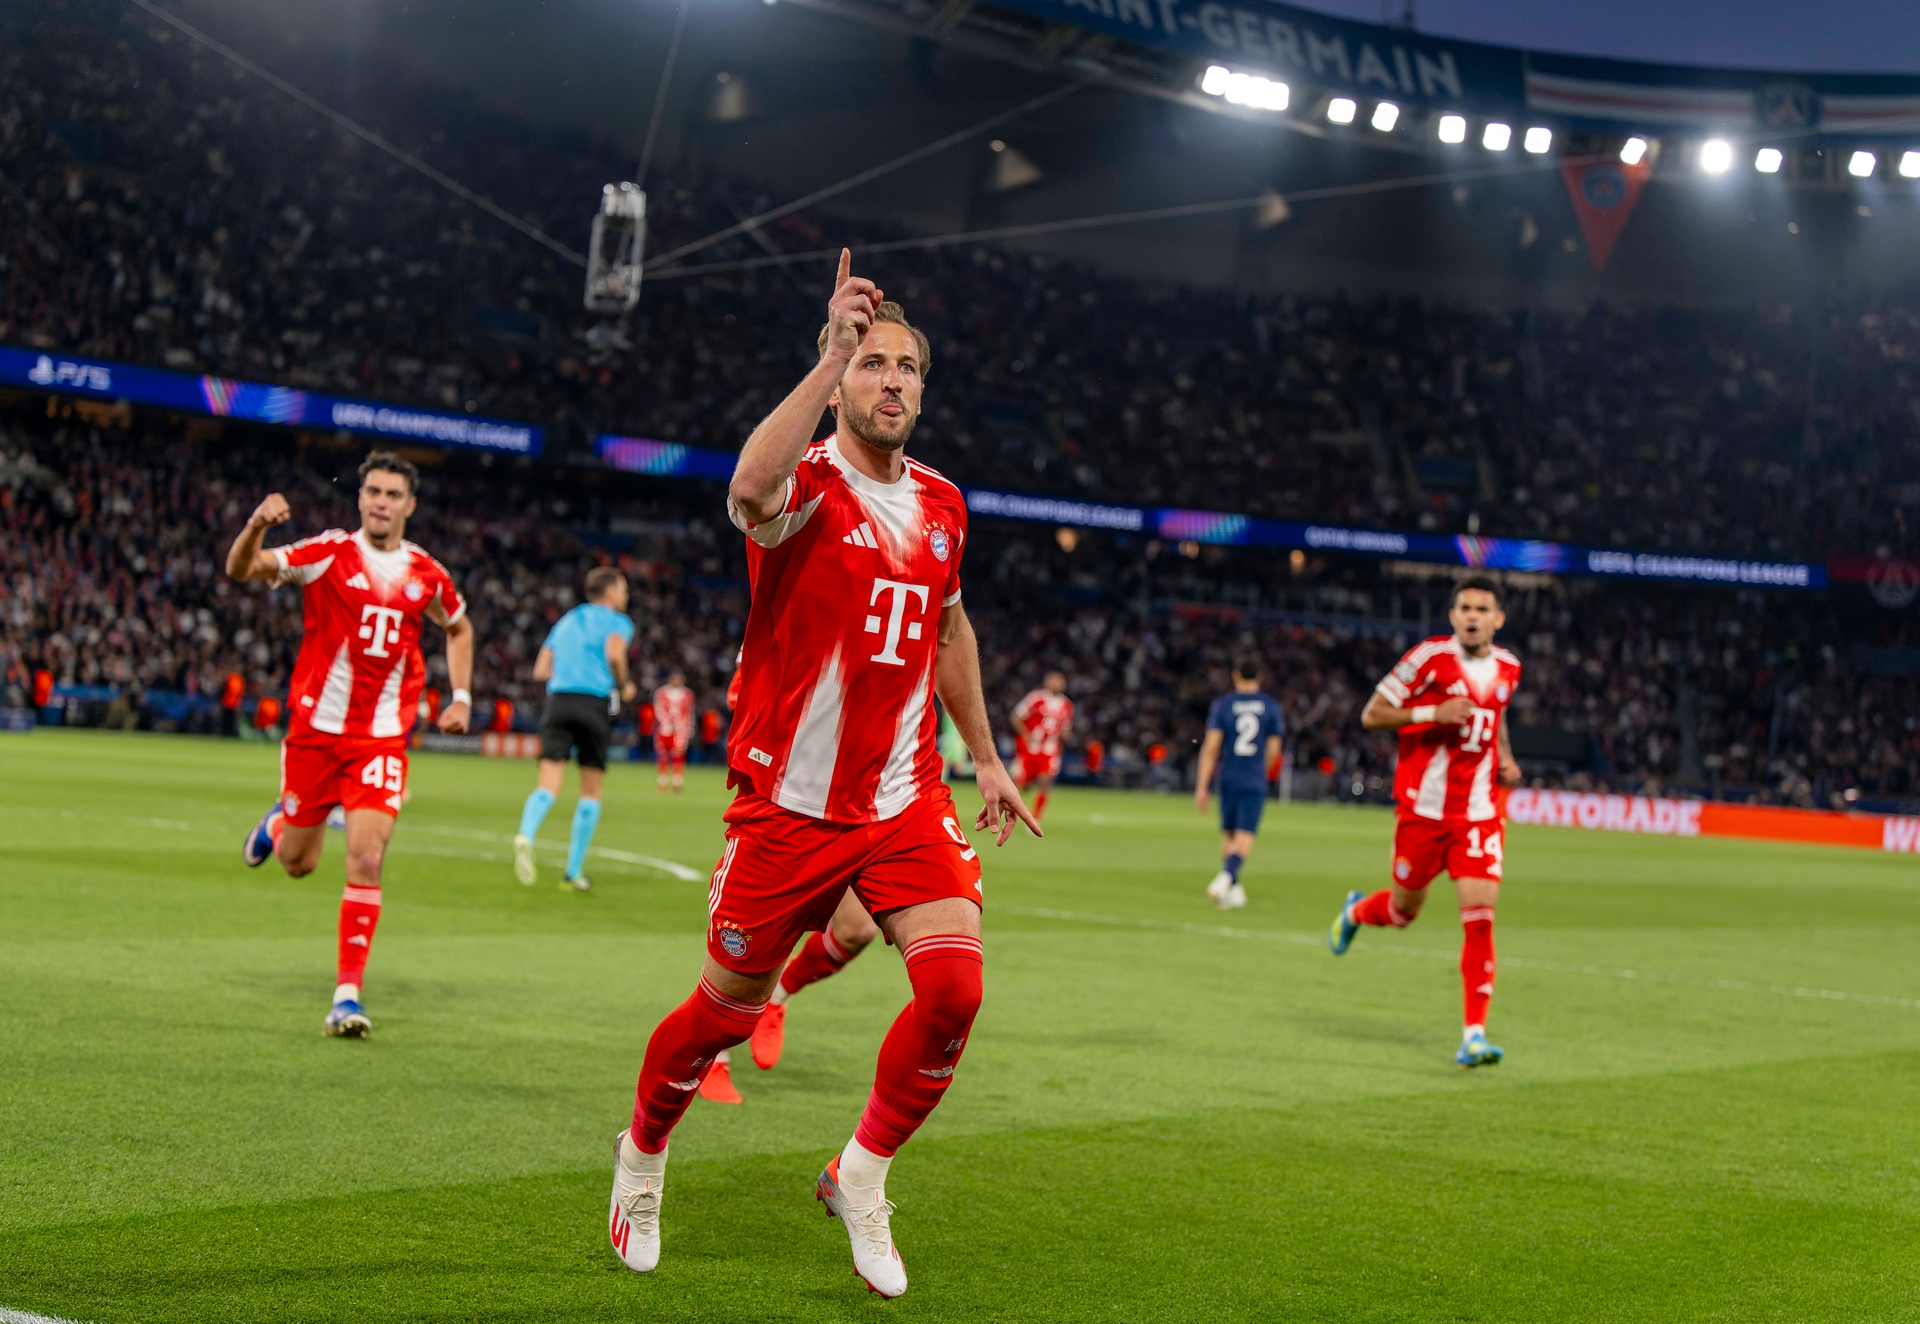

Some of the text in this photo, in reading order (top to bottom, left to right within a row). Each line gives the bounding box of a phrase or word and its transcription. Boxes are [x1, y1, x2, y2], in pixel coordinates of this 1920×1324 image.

[359, 604, 403, 658] T
[864, 578, 929, 666] T
[1233, 711, 1260, 757] 2
[361, 755, 402, 792] 45
[1506, 787, 1701, 836] GATORADE
[942, 816, 976, 862] 9
[1467, 826, 1503, 861] 14
